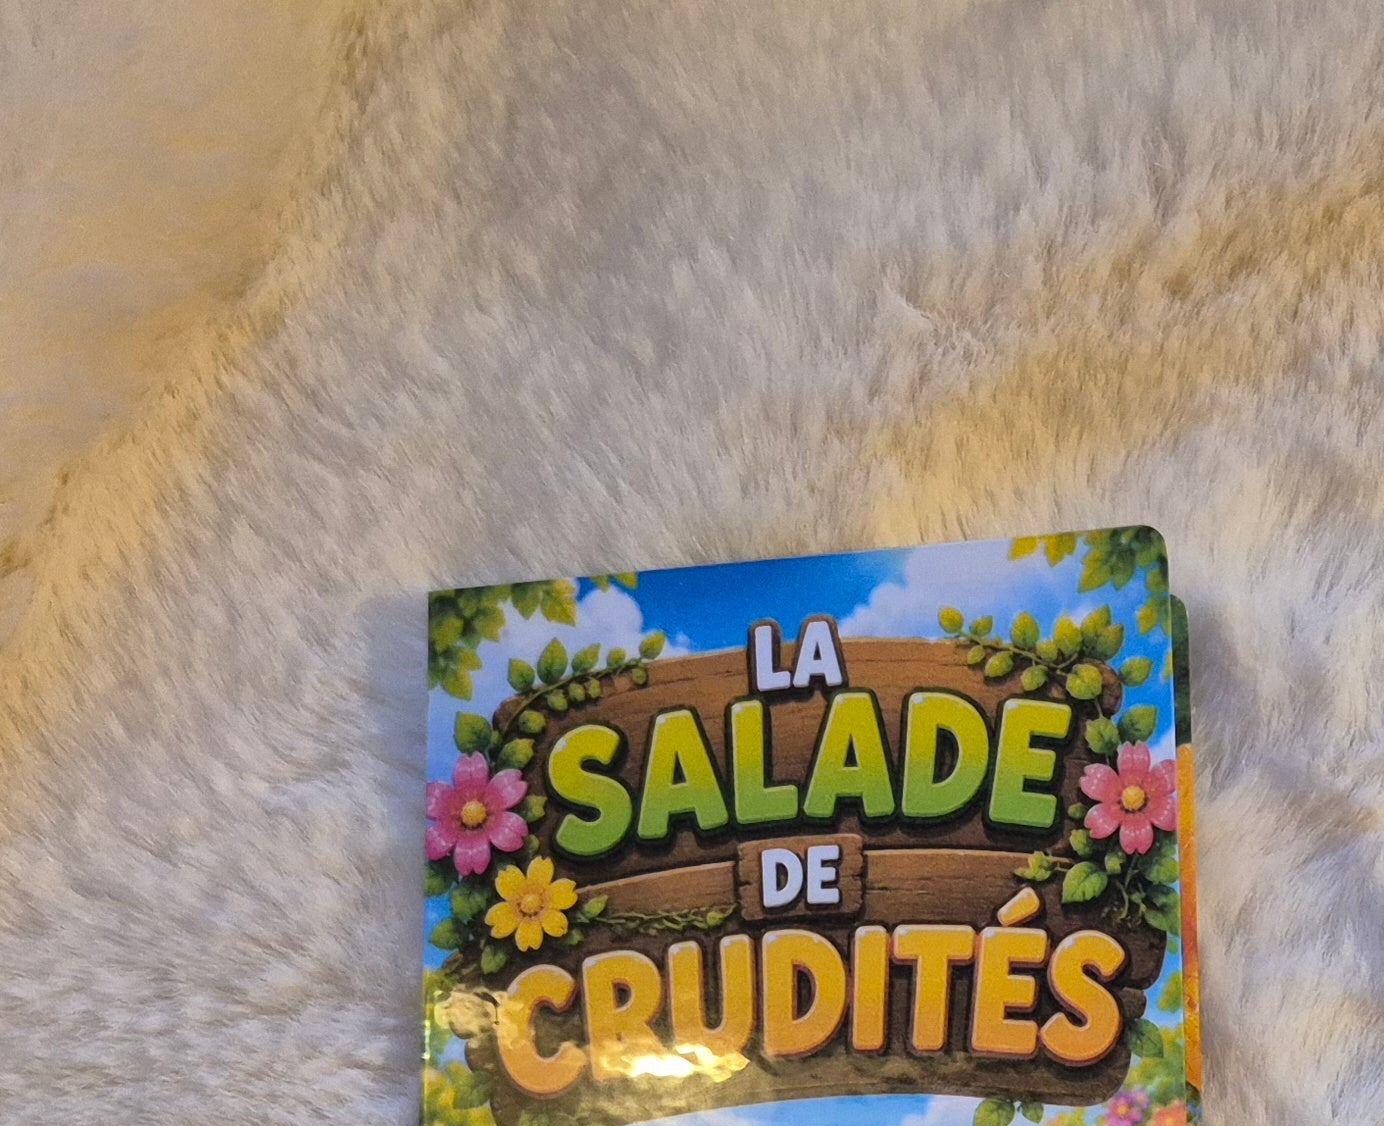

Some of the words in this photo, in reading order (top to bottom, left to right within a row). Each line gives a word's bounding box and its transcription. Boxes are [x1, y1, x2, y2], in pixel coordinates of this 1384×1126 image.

[752, 620, 844, 692] LA
[546, 689, 1073, 859] SALADE
[760, 846, 841, 907] DE
[496, 885, 1126, 1096] CRUDITÉS
